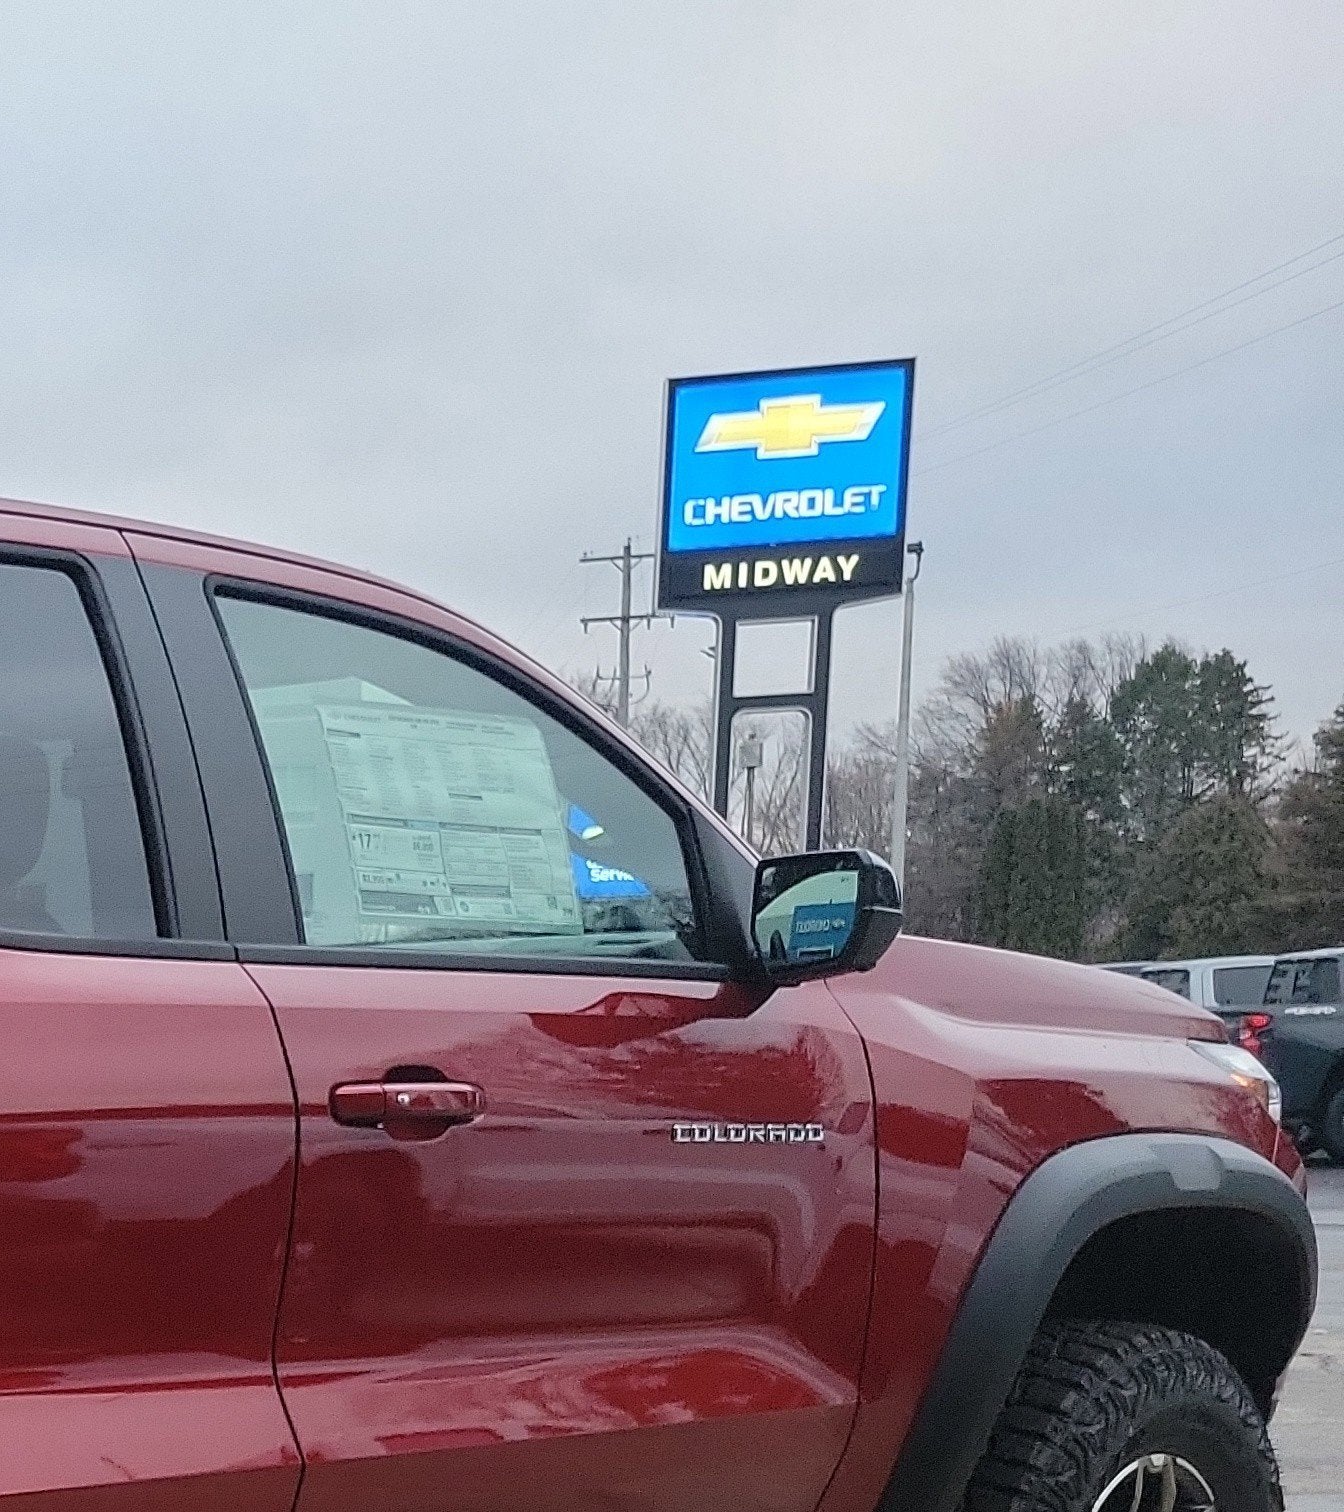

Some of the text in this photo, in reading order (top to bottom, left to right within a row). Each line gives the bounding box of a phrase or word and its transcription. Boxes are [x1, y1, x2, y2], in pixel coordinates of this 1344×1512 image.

[683, 484, 887, 526] CHEVROLET
[703, 554, 860, 590] MIDWAY
[672, 1123, 825, 1143] COLORADO
